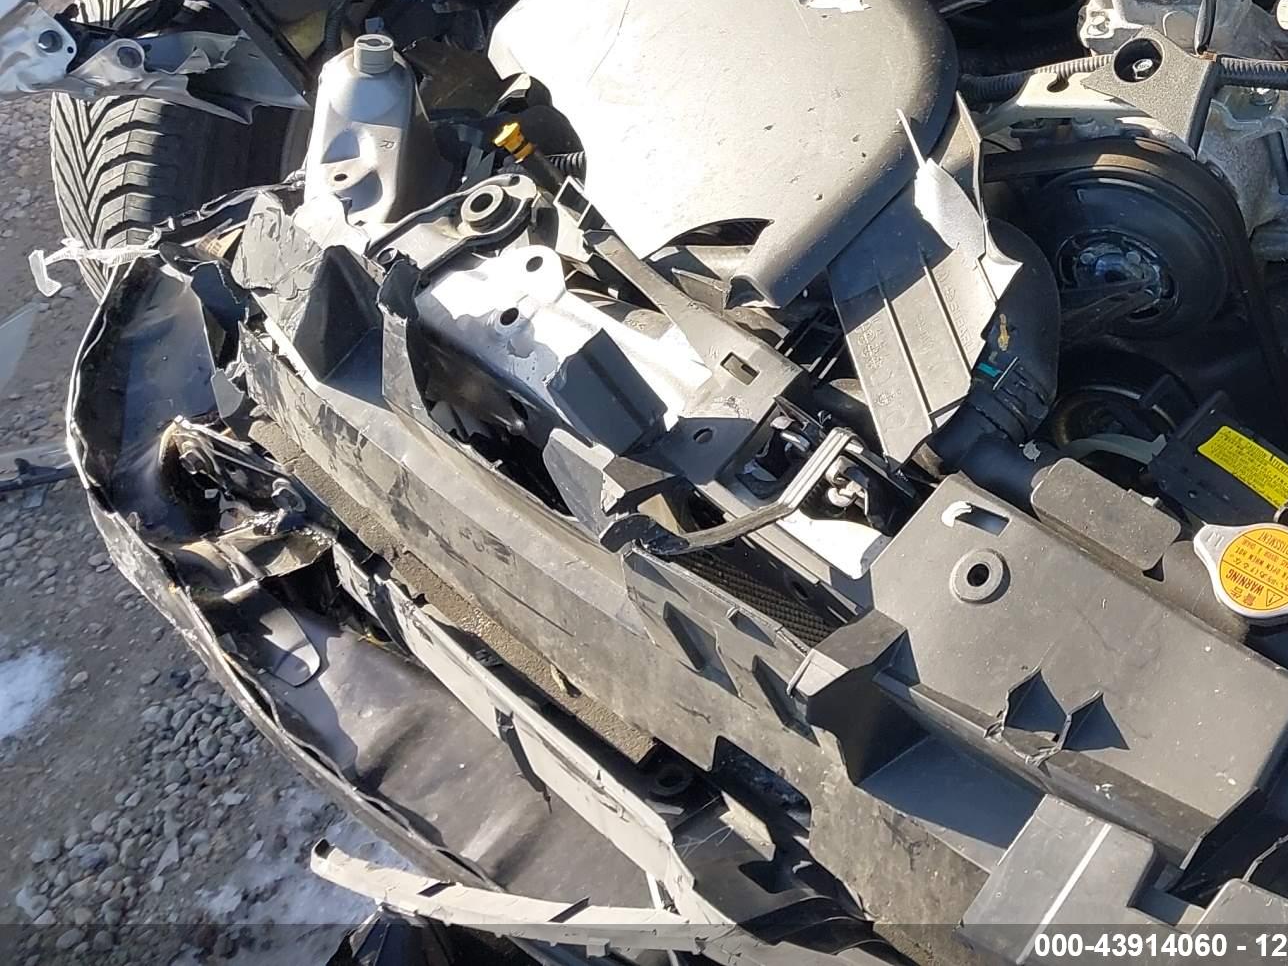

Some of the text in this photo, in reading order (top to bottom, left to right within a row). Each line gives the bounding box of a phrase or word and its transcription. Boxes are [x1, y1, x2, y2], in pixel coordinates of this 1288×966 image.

[1247, 552, 1265, 566] WHEN
[1264, 561, 1281, 575] OPEN
[1224, 567, 1265, 596] WARNING
